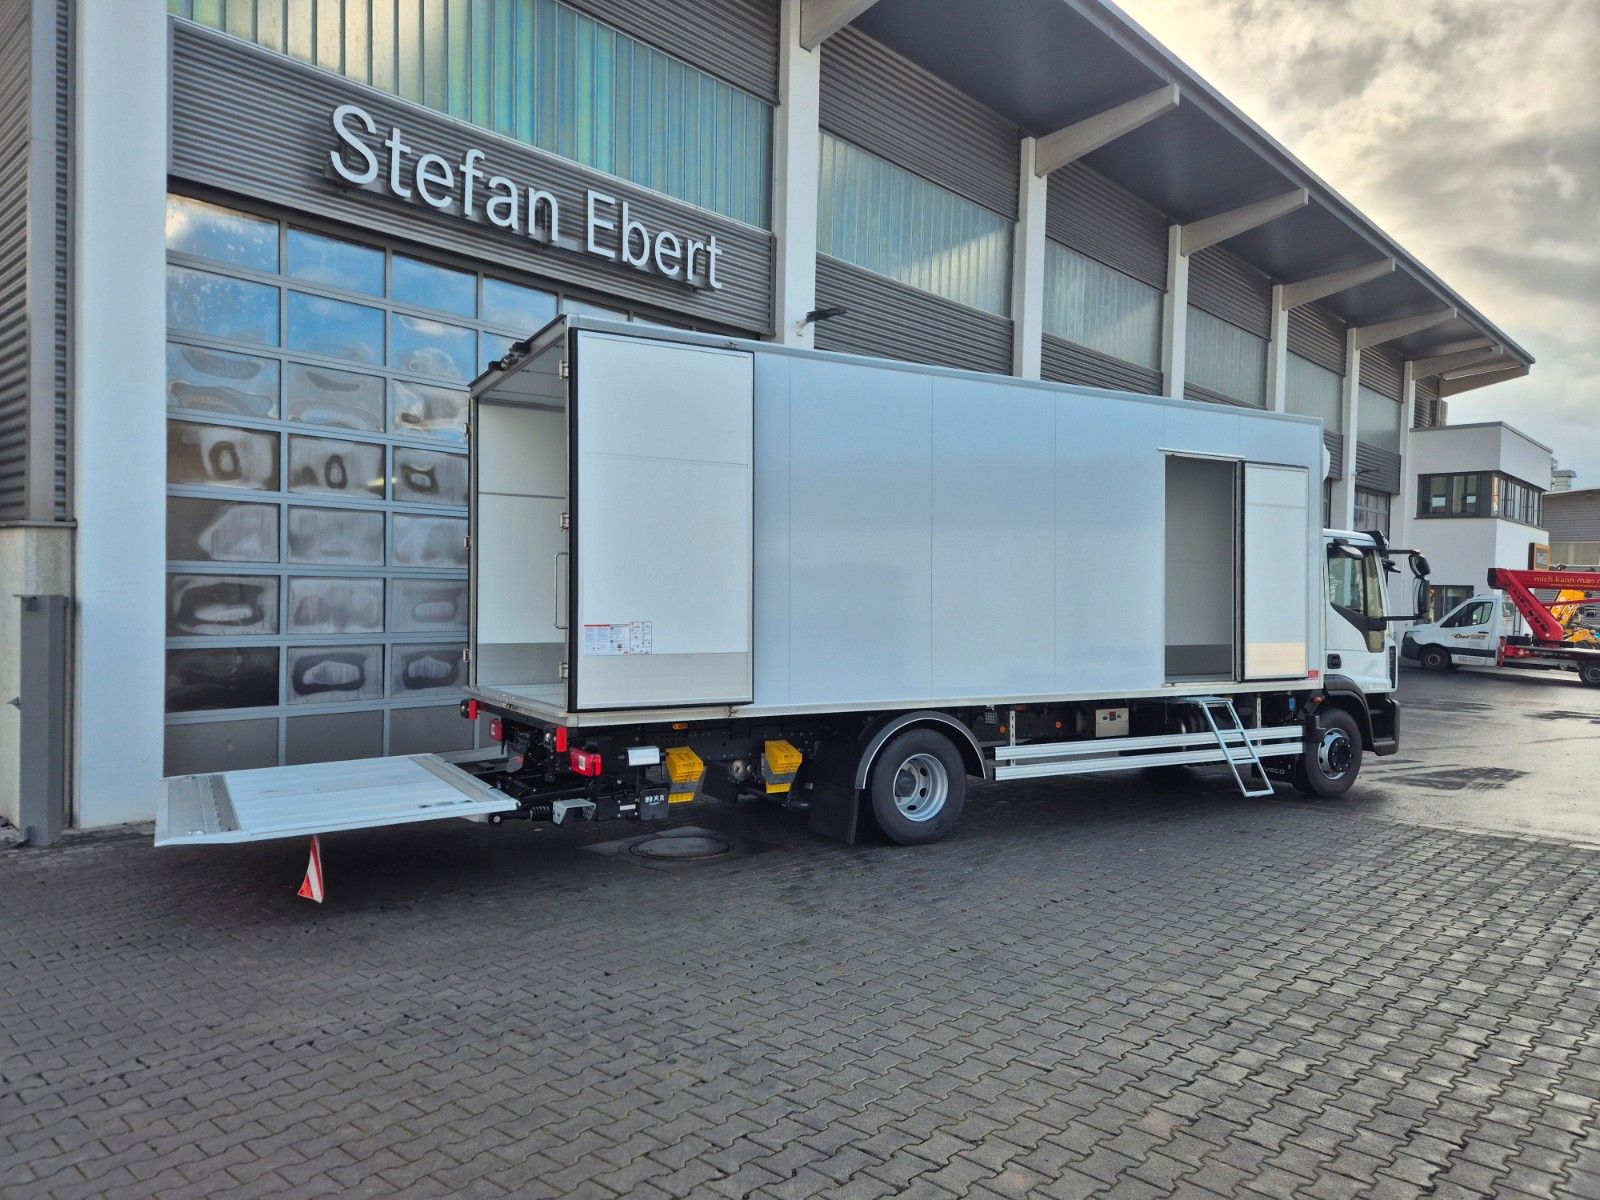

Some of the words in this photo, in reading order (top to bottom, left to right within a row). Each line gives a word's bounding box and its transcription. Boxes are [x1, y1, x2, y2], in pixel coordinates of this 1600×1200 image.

[330, 104, 559, 242] Stefan
[586, 189, 723, 289] Ebert
[1555, 576, 1575, 584] kann
[1577, 577, 1595, 585] man
